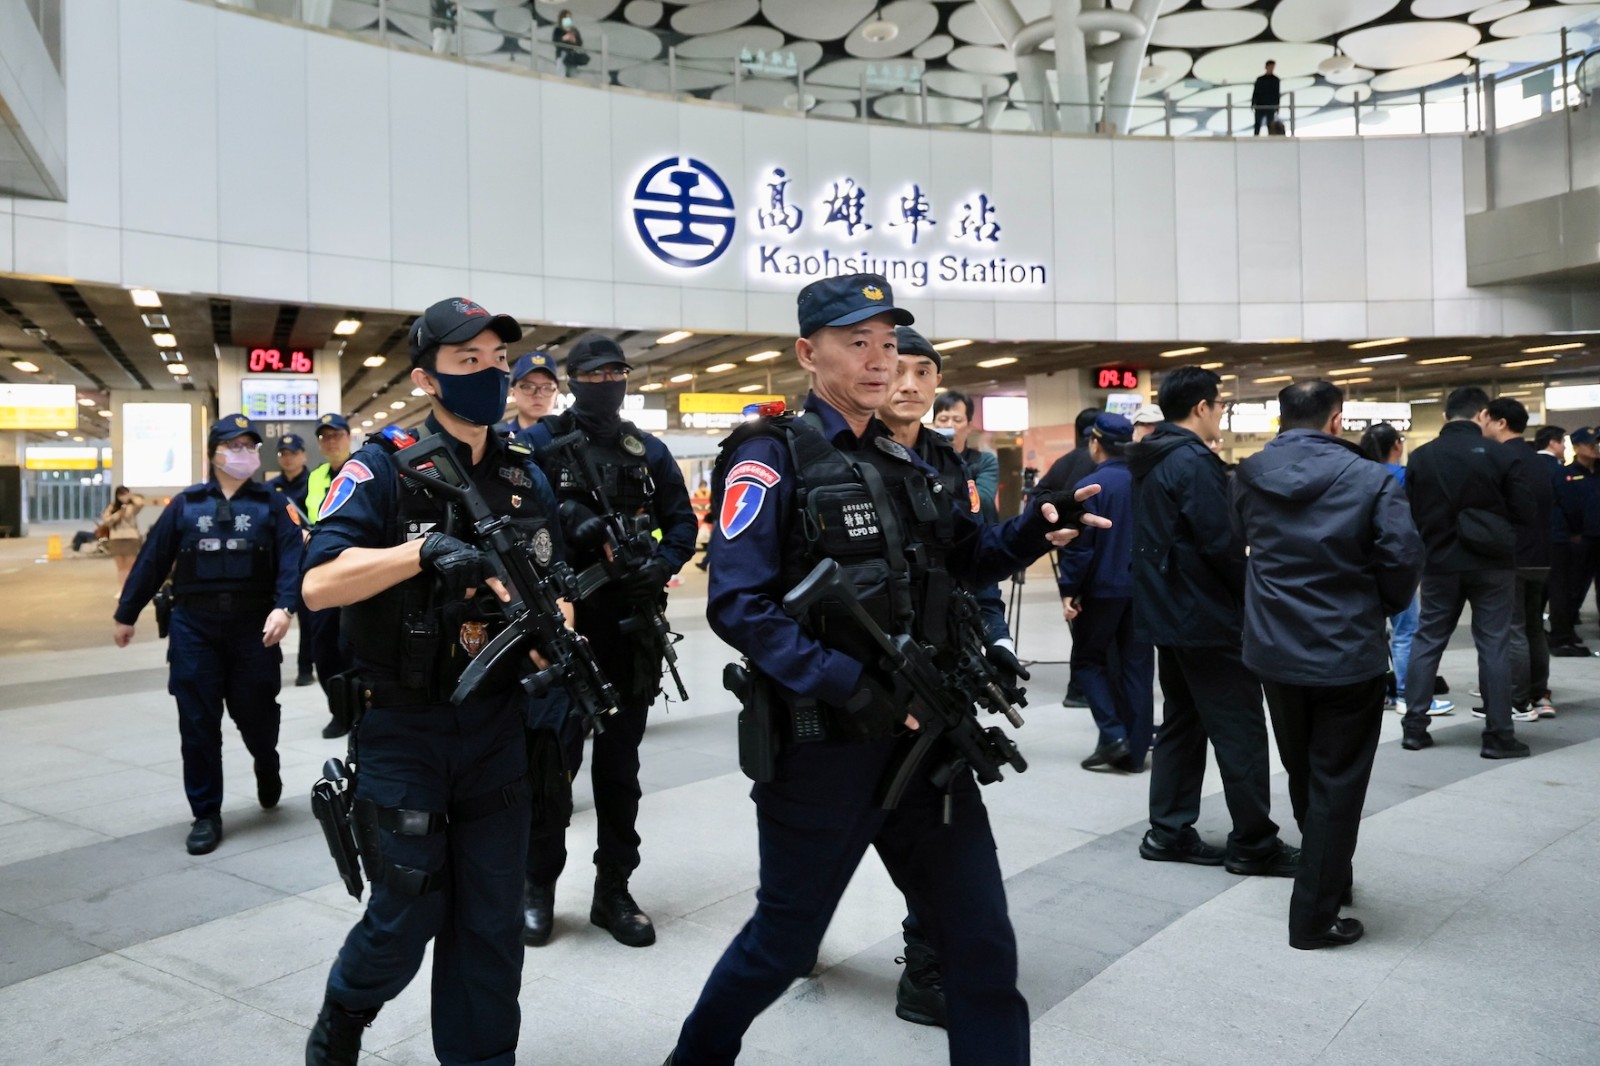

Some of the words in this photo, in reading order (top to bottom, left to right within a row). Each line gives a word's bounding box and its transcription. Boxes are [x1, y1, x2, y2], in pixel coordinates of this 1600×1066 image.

[758, 168, 1001, 244] 高雄車站
[760, 246, 928, 287] Kaohsiung
[939, 255, 1046, 284] Station
[196, 514, 252, 533] 警察
[844, 511, 876, 527] 特勤中
[848, 527, 868, 537] KCPD
